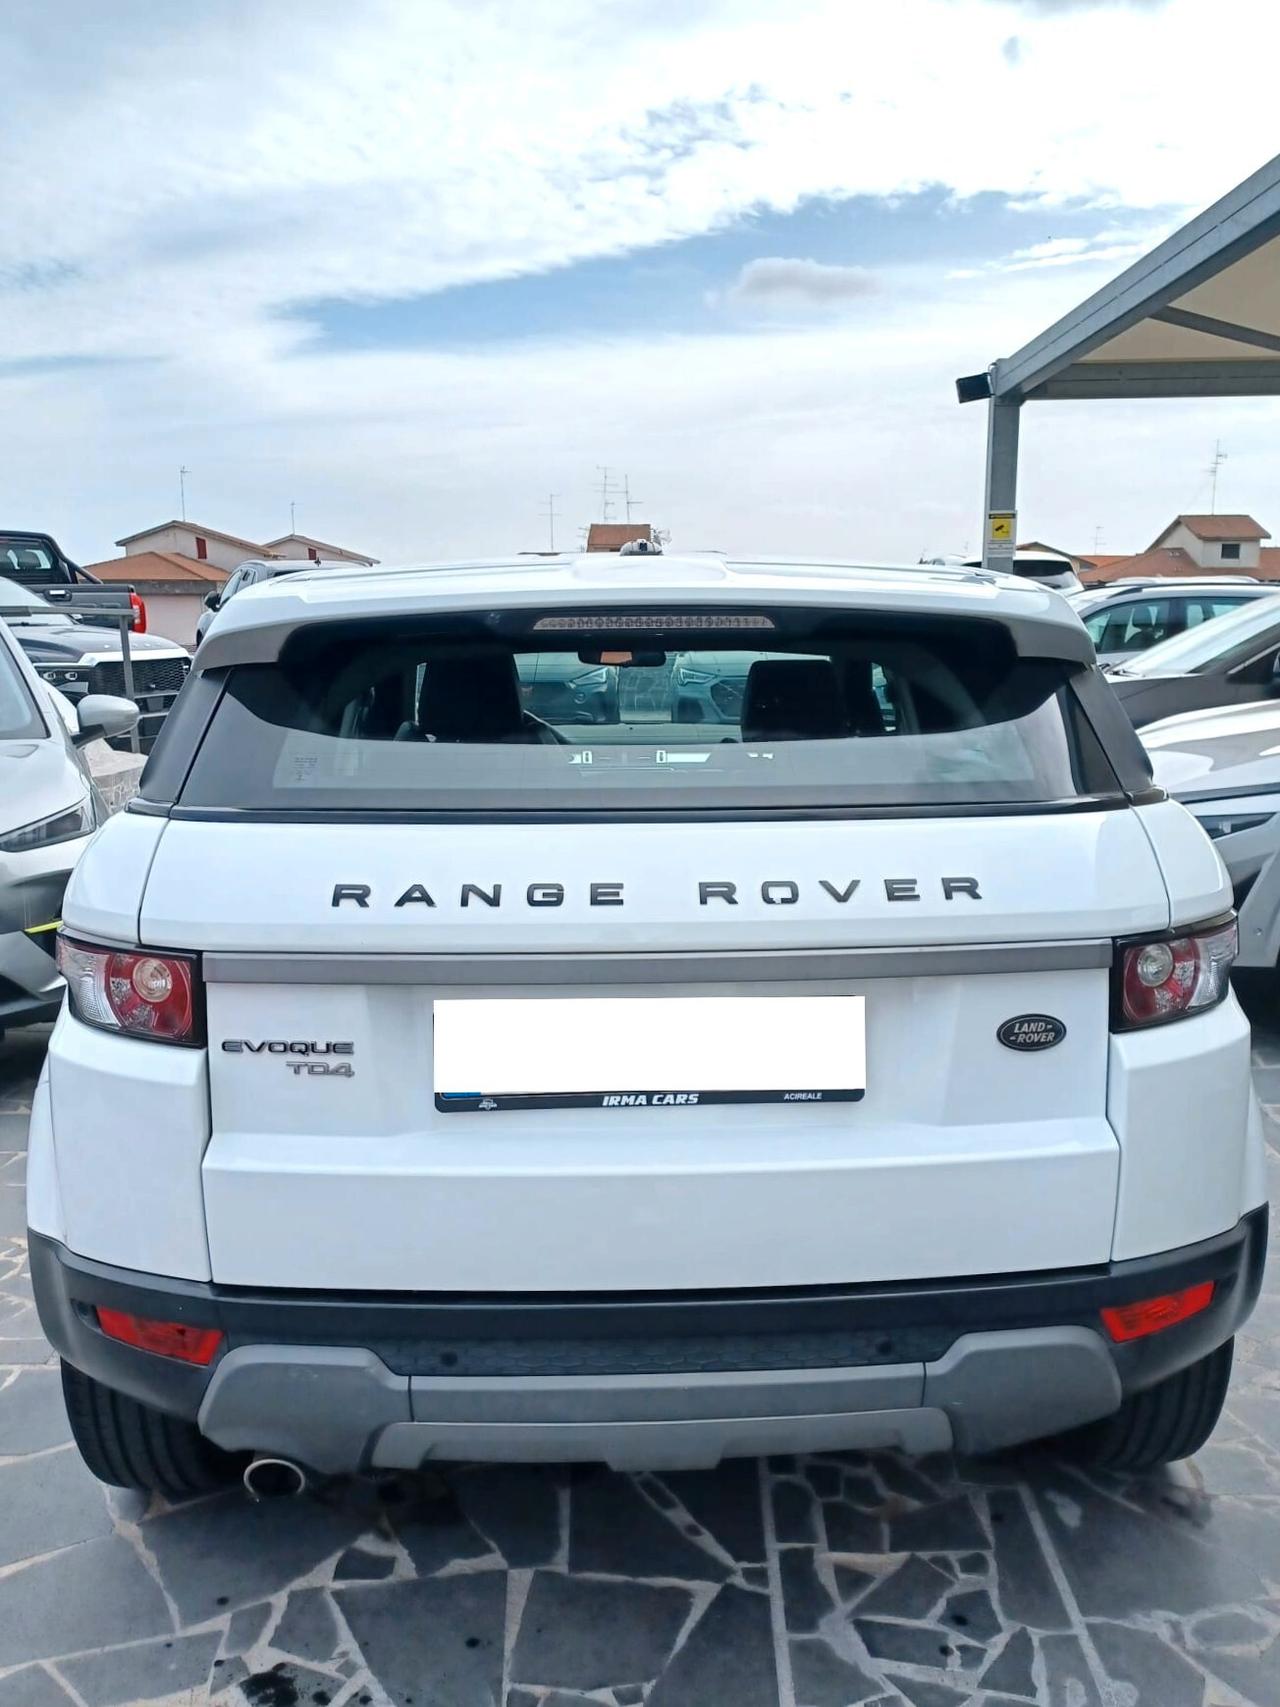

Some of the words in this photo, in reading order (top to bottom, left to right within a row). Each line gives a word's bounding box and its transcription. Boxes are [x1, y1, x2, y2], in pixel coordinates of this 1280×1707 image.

[332, 882, 624, 908] RANGE
[699, 877, 983, 905] ROVER
[221, 1039, 355, 1056] EVOQUE
[286, 1061, 355, 1078] TD4
[602, 1094, 647, 1106] IRMA
[652, 1092, 699, 1105] CARS
[784, 1092, 823, 1100] ACIREALE
